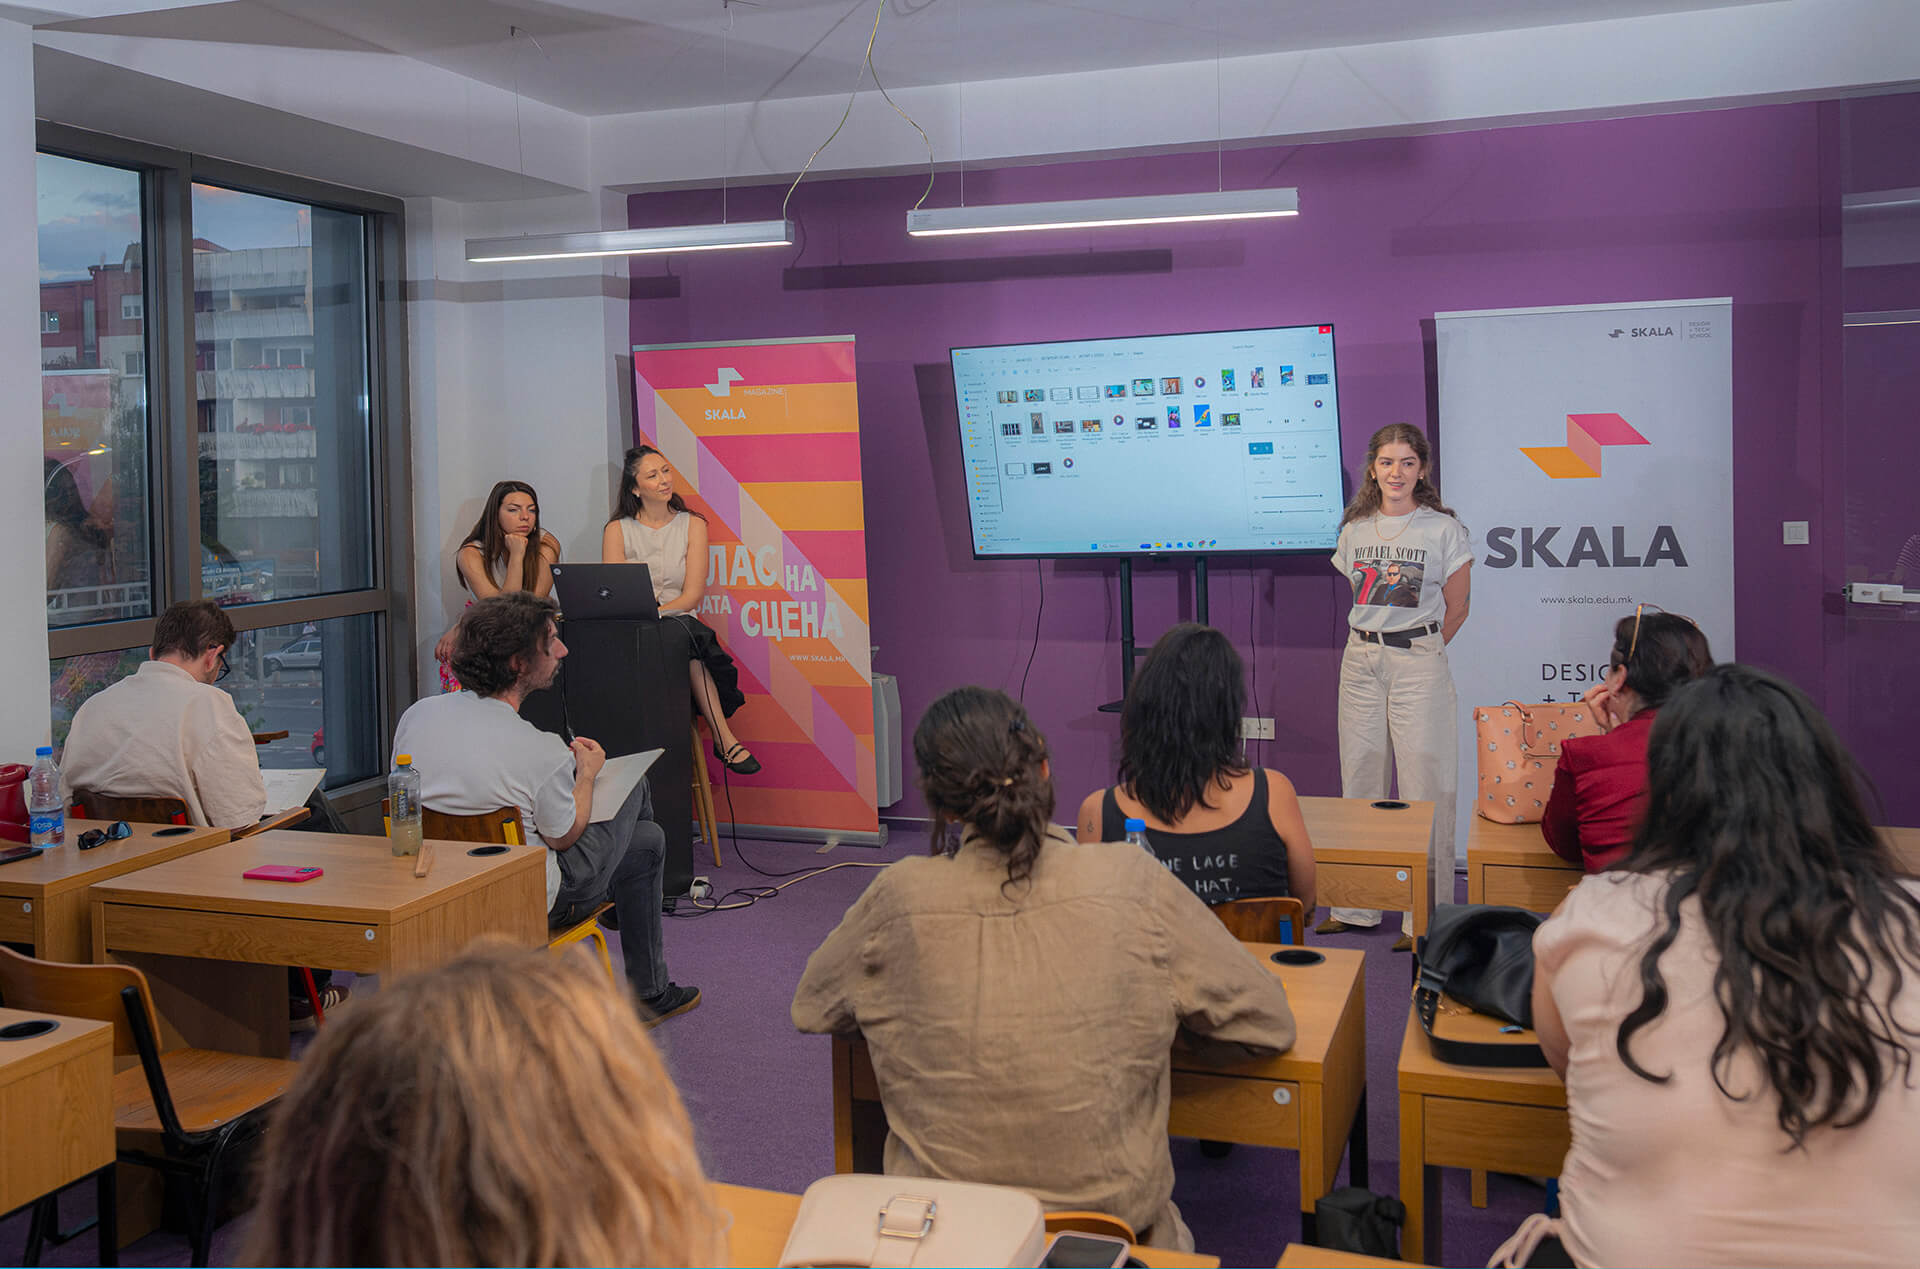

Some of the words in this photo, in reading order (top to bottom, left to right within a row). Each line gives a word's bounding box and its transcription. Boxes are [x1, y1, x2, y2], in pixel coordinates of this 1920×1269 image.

[1631, 326, 1674, 338] SKALA
[704, 408, 746, 421] SKALA
[1354, 546, 1393, 560] MICHAEL
[1395, 547, 1427, 562] SCOTT
[1484, 525, 1689, 569] SKALA
[706, 545, 777, 587] ЛАС
[785, 564, 818, 592] НА
[1540, 595, 1633, 605] www.skala.edu.mk
[696, 595, 732, 615] АТА
[740, 600, 844, 641] СЦЕНА
